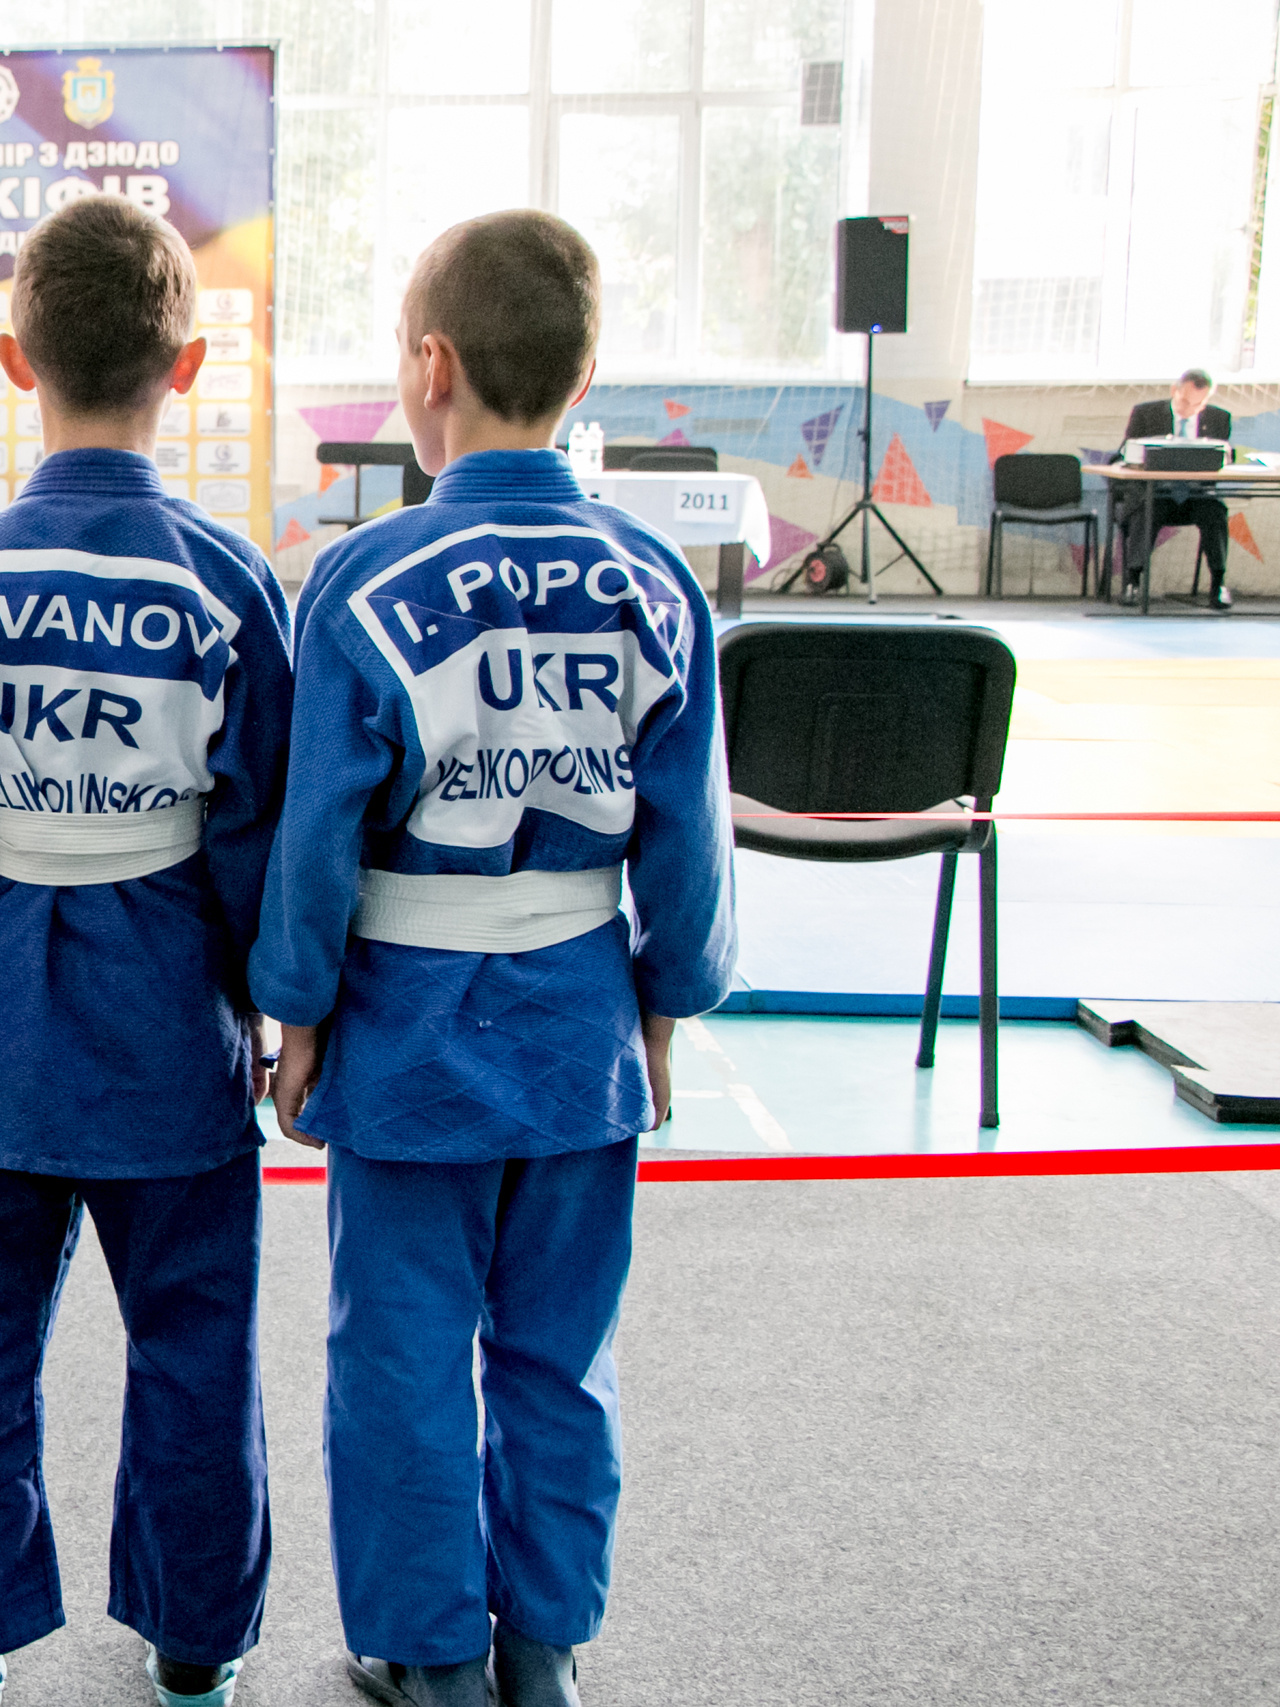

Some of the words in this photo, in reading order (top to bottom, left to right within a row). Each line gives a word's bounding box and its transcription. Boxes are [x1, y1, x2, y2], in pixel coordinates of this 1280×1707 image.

[39, 142, 58, 167] З
[63, 140, 179, 170] ДЗЮДО
[680, 492, 729, 511] 2011
[393, 600, 439, 644] I.
[478, 648, 620, 713] UKR
